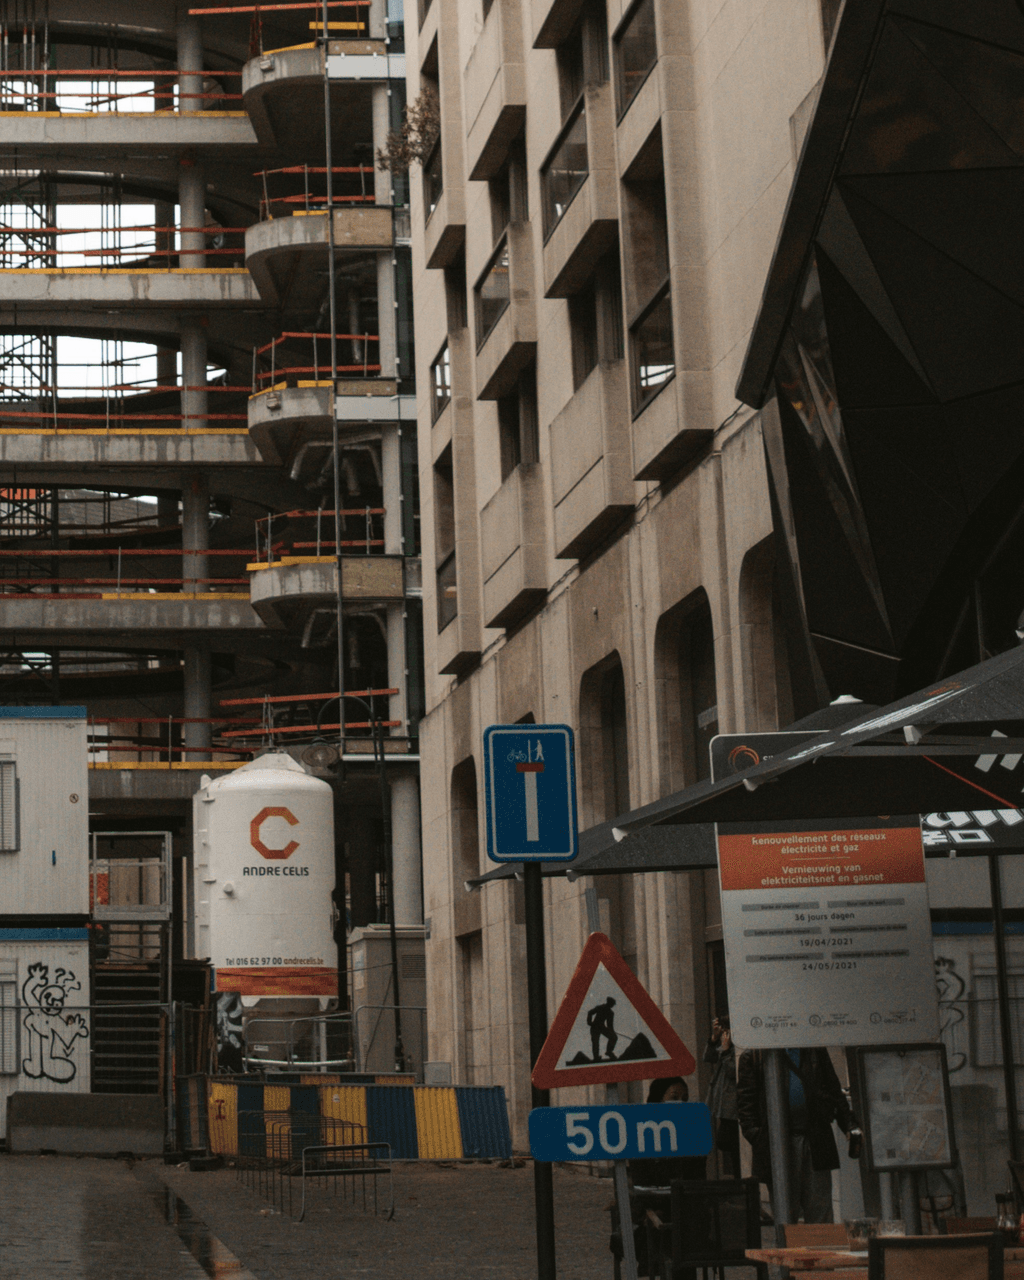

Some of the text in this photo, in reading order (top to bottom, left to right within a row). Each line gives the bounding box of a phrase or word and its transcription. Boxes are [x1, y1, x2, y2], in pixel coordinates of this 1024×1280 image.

[250, 806, 300, 859] C
[751, 832, 886, 846] Renouvellement des réseaux
[781, 844, 859, 854] électricité et gaz
[243, 866, 309, 876] ANDRE CELIS
[781, 864, 861, 875] Vernieuwing van
[761, 875, 835, 886] elektriciteitsnet
[852, 873, 884, 883] gasnet
[795, 912, 855, 923] 36 jours dagen
[799, 938, 853, 947] 19/04/2021
[226, 957, 324, 966] Tel 016 62 97 00 andrecelis.be
[802, 962, 858, 971] 24/05/2021
[566, 1111, 678, 1155] 50 m
